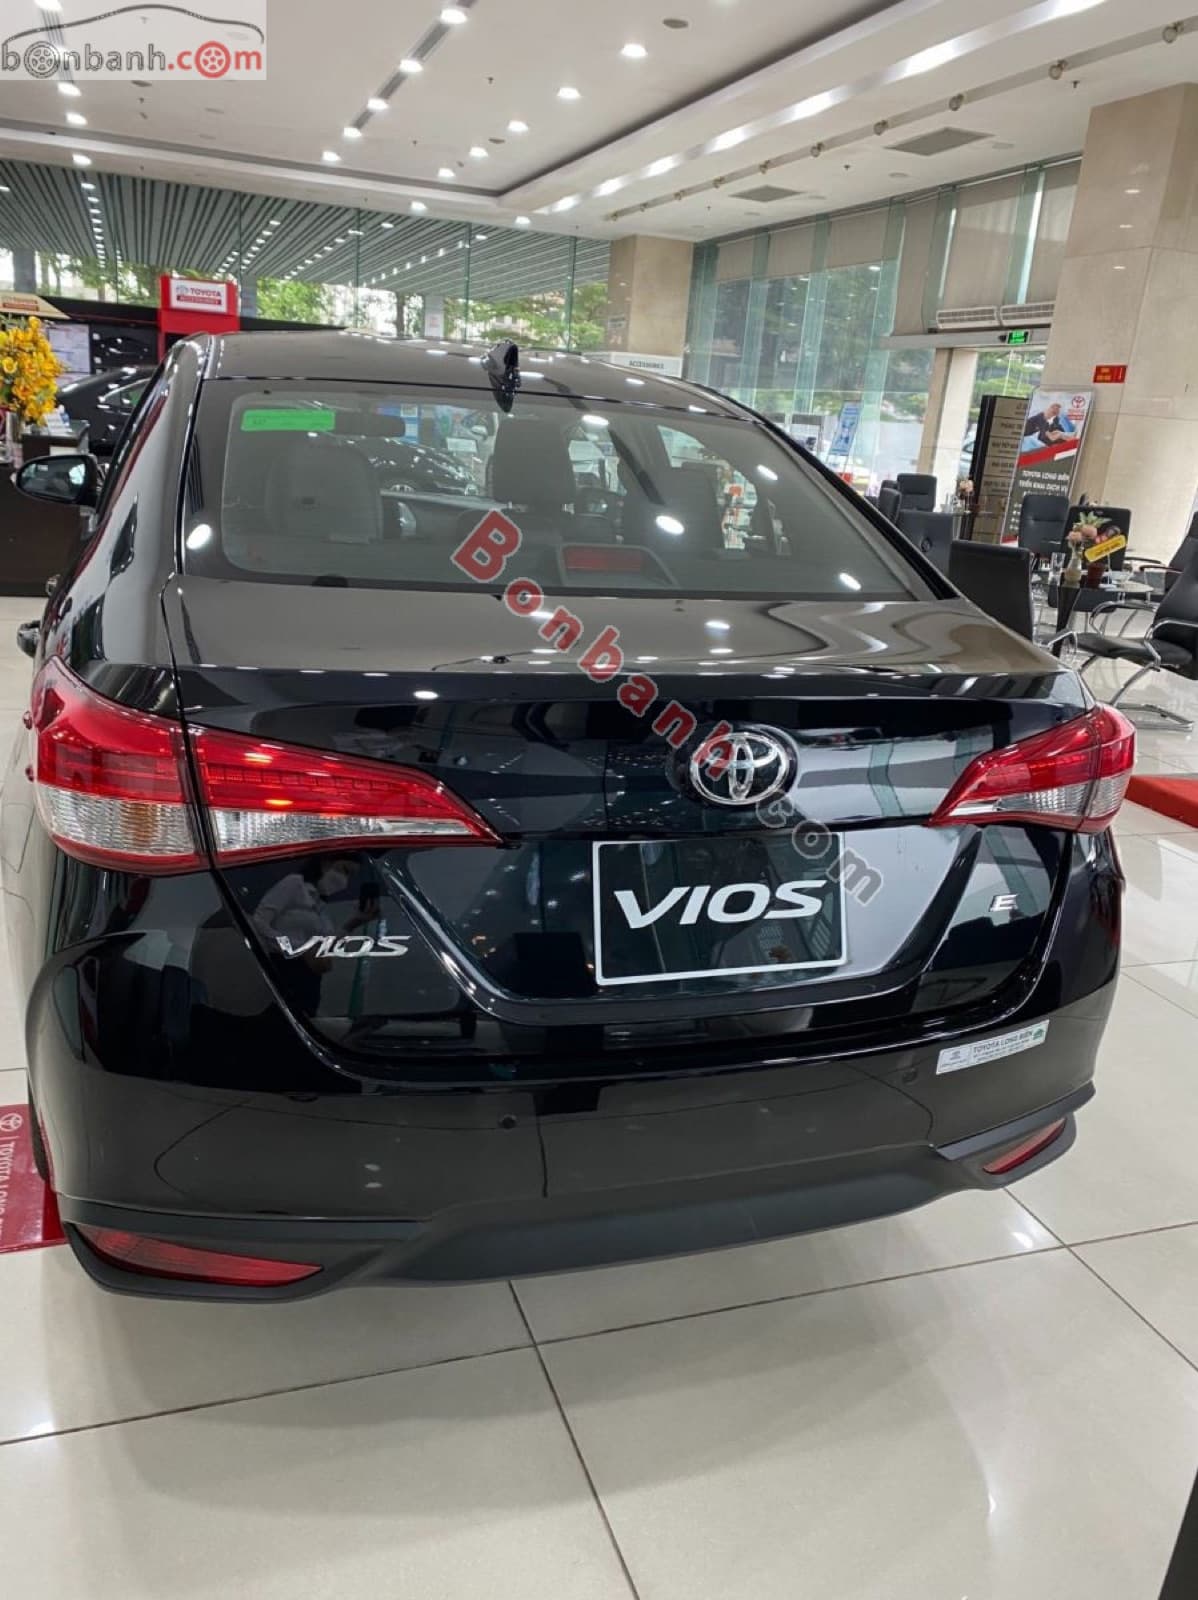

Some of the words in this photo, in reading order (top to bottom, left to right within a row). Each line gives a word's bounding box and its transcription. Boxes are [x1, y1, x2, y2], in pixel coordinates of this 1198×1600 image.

[190, 287, 221, 297] TOYOTA
[614, 879, 828, 929] VIOS
[989, 894, 1019, 912] E
[276, 935, 412, 959] VIOS
[973, 1040, 999, 1053] TOYOTA
[1000, 1034, 1018, 1046] LONG
